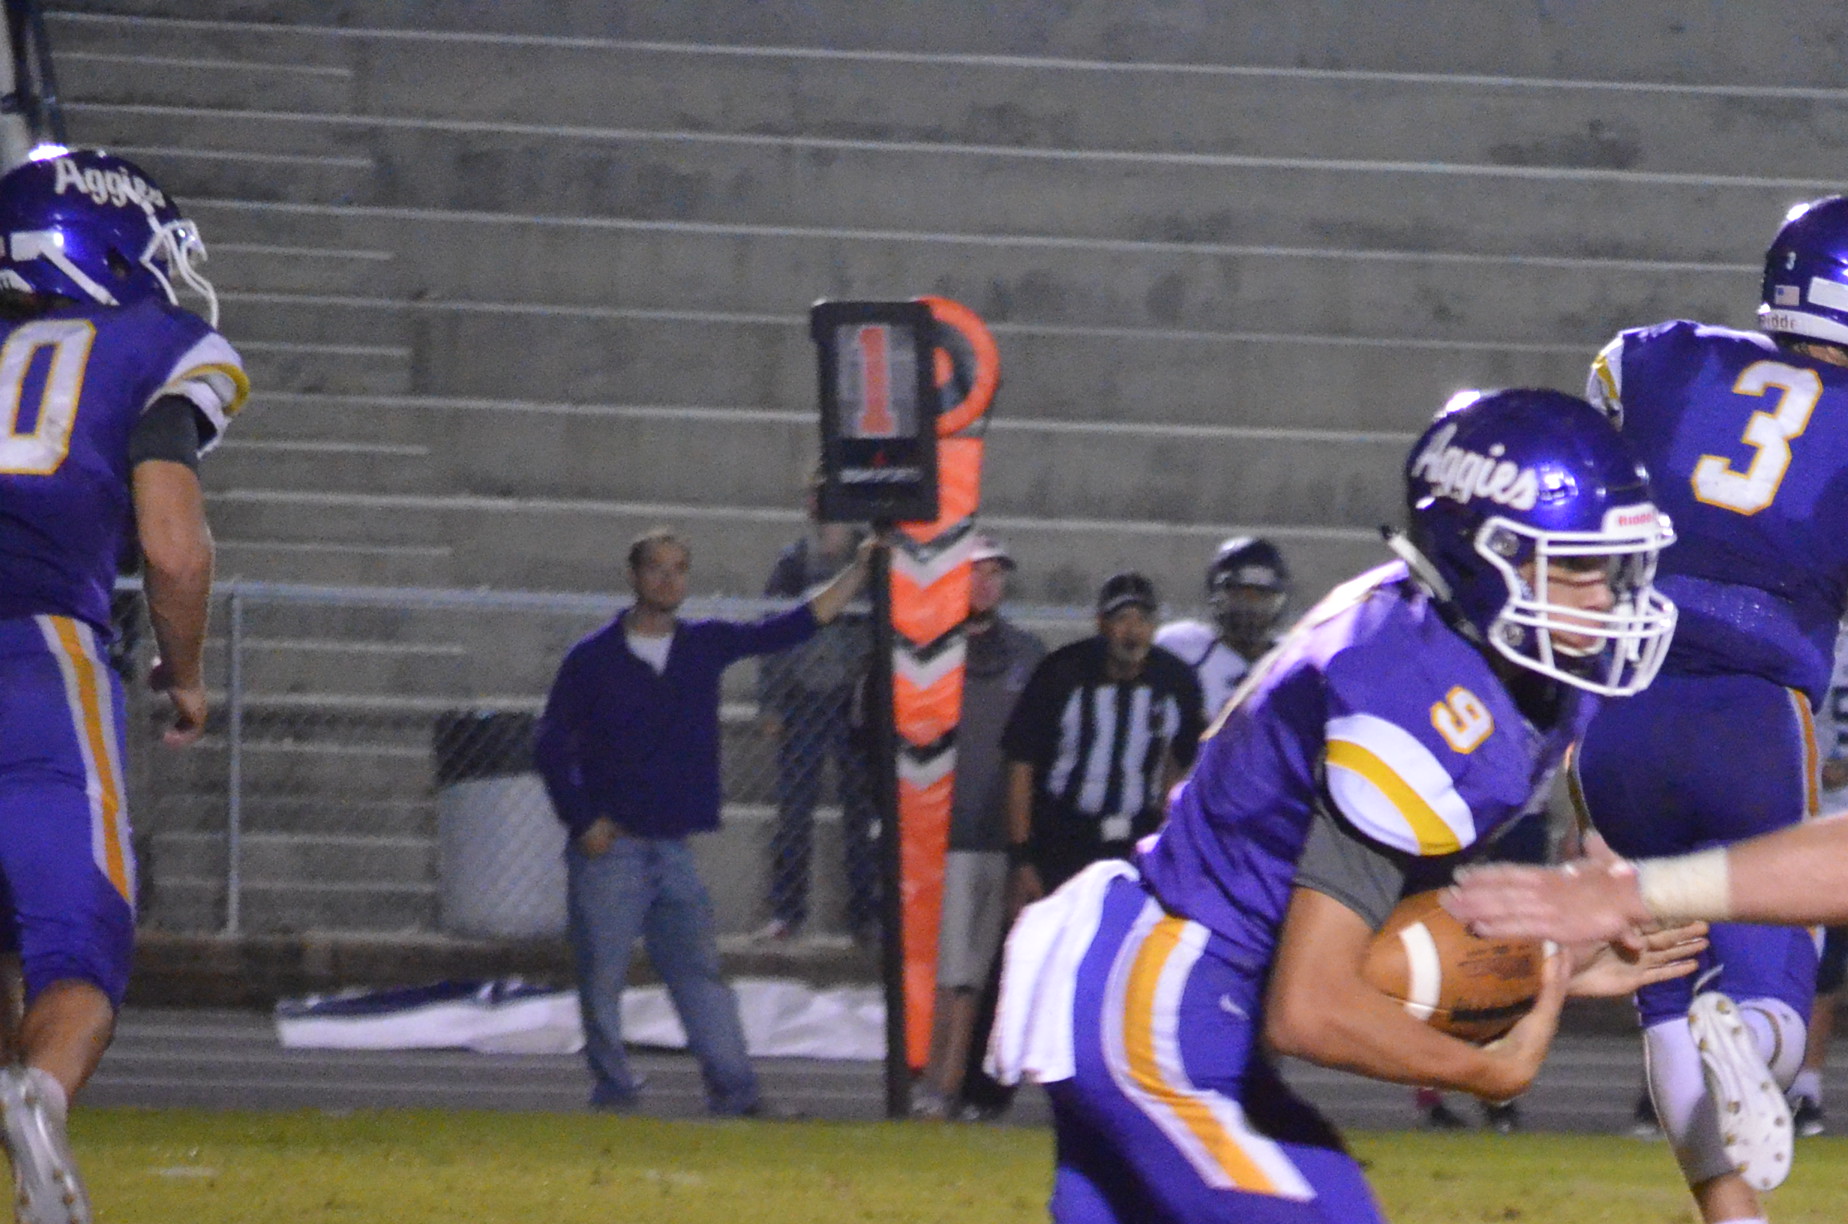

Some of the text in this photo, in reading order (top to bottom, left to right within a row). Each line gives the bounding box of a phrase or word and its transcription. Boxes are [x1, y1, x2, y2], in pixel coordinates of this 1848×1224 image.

[0, 318, 98, 476] 0
[859, 327, 893, 434] 1
[1690, 360, 1824, 517] 3
